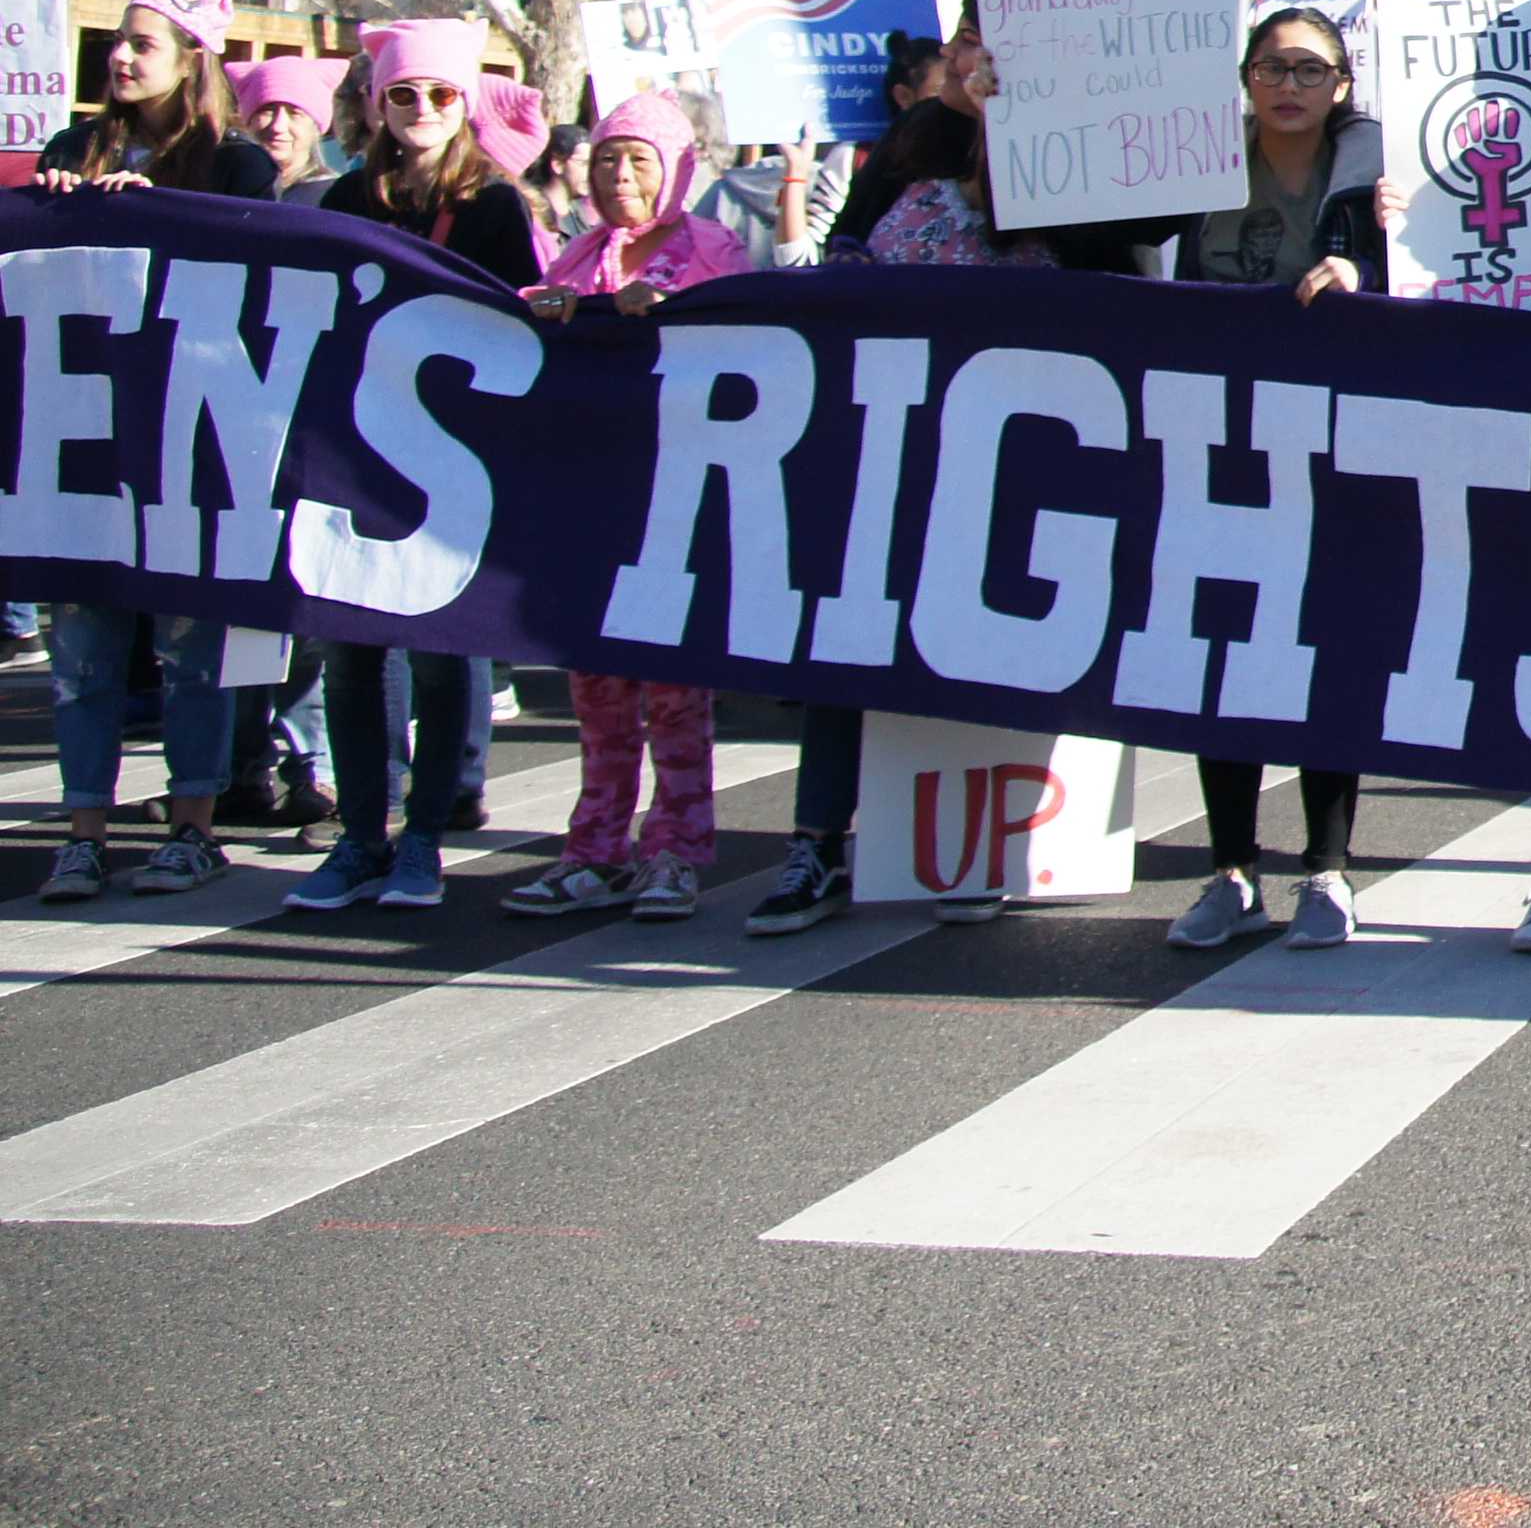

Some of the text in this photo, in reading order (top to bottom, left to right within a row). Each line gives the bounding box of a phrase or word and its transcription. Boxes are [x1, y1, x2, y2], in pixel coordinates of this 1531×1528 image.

[995, 10, 1231, 62] of the WITCHES
[1429, 0, 1520, 27] THE
[768, 32, 891, 57] CINDY
[995, 58, 1163, 125] you could
[1008, 97, 1240, 201] NOT BURN!
[1452, 247, 1517, 285] IS
[913, 763, 1067, 894] UP.
